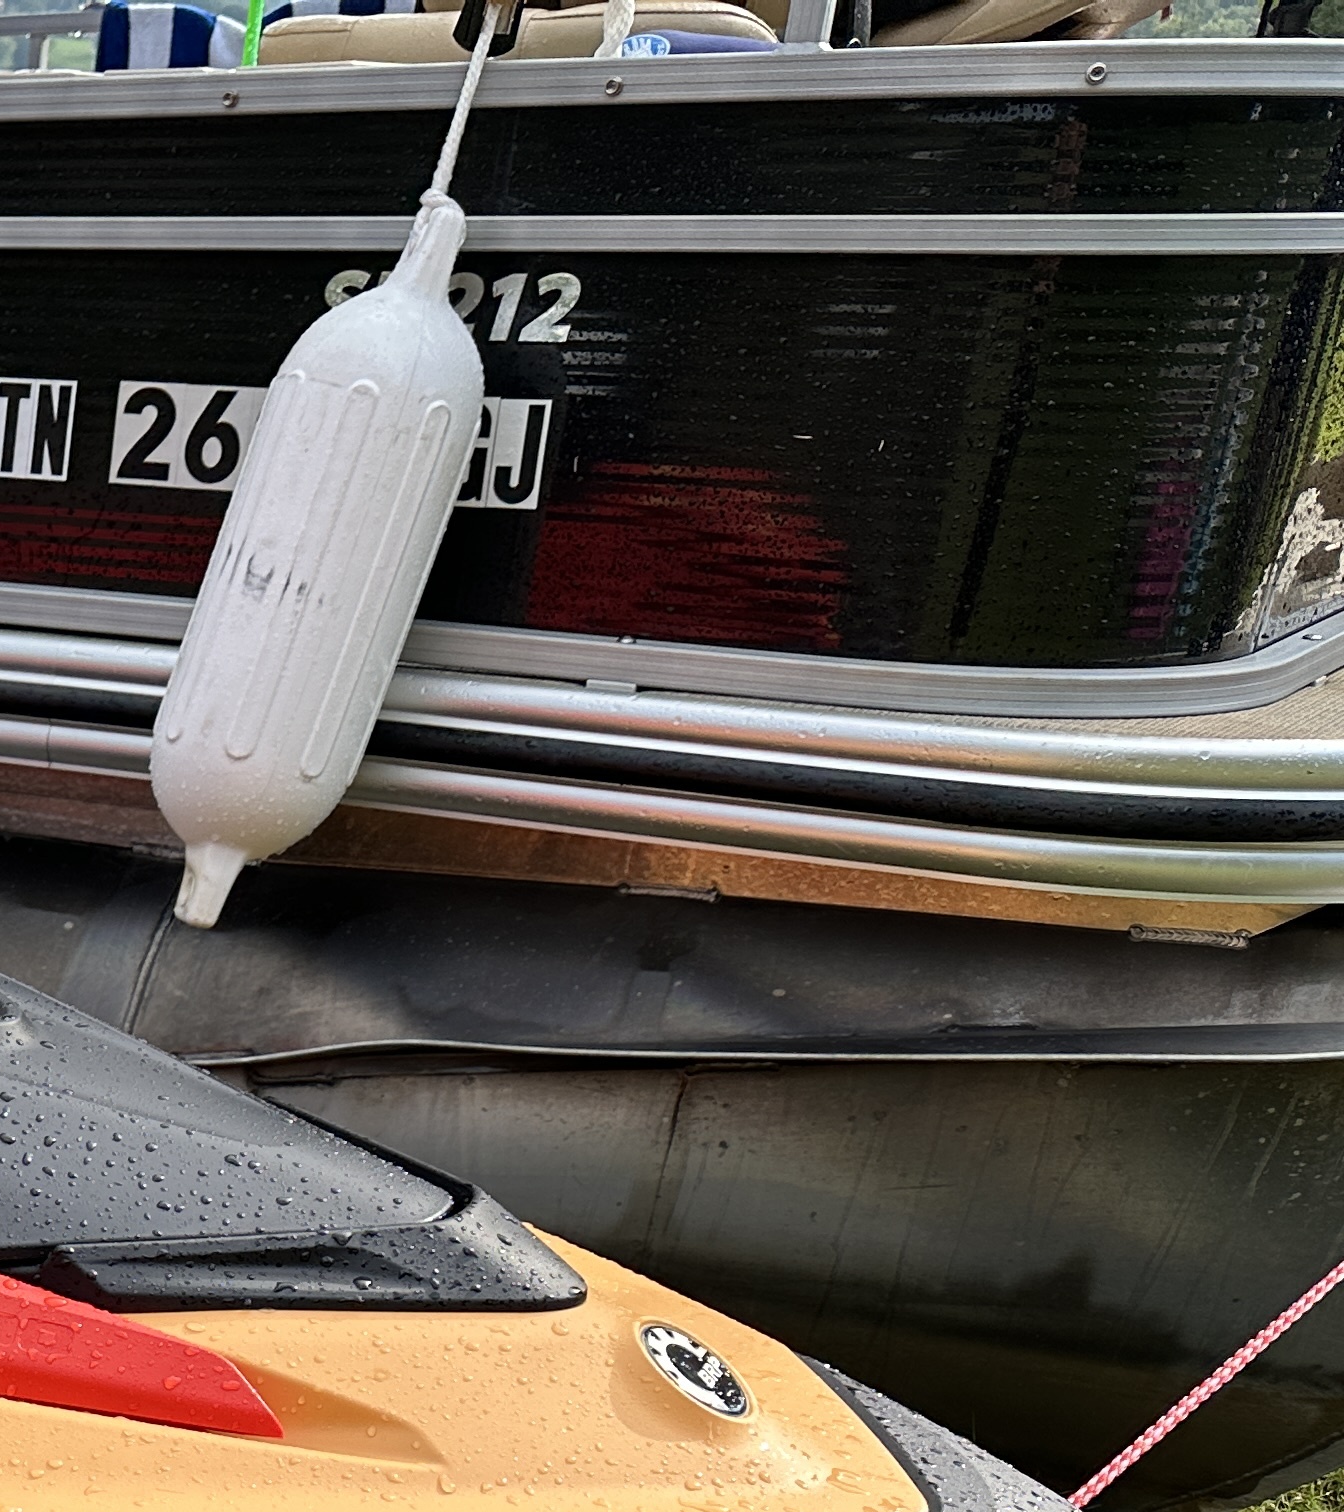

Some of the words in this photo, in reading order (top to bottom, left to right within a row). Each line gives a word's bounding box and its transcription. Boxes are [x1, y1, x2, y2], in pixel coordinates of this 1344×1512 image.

[324, 269, 582, 343] 212
[117, 387, 242, 484] 26
[698, 1355, 723, 1388] BRP
